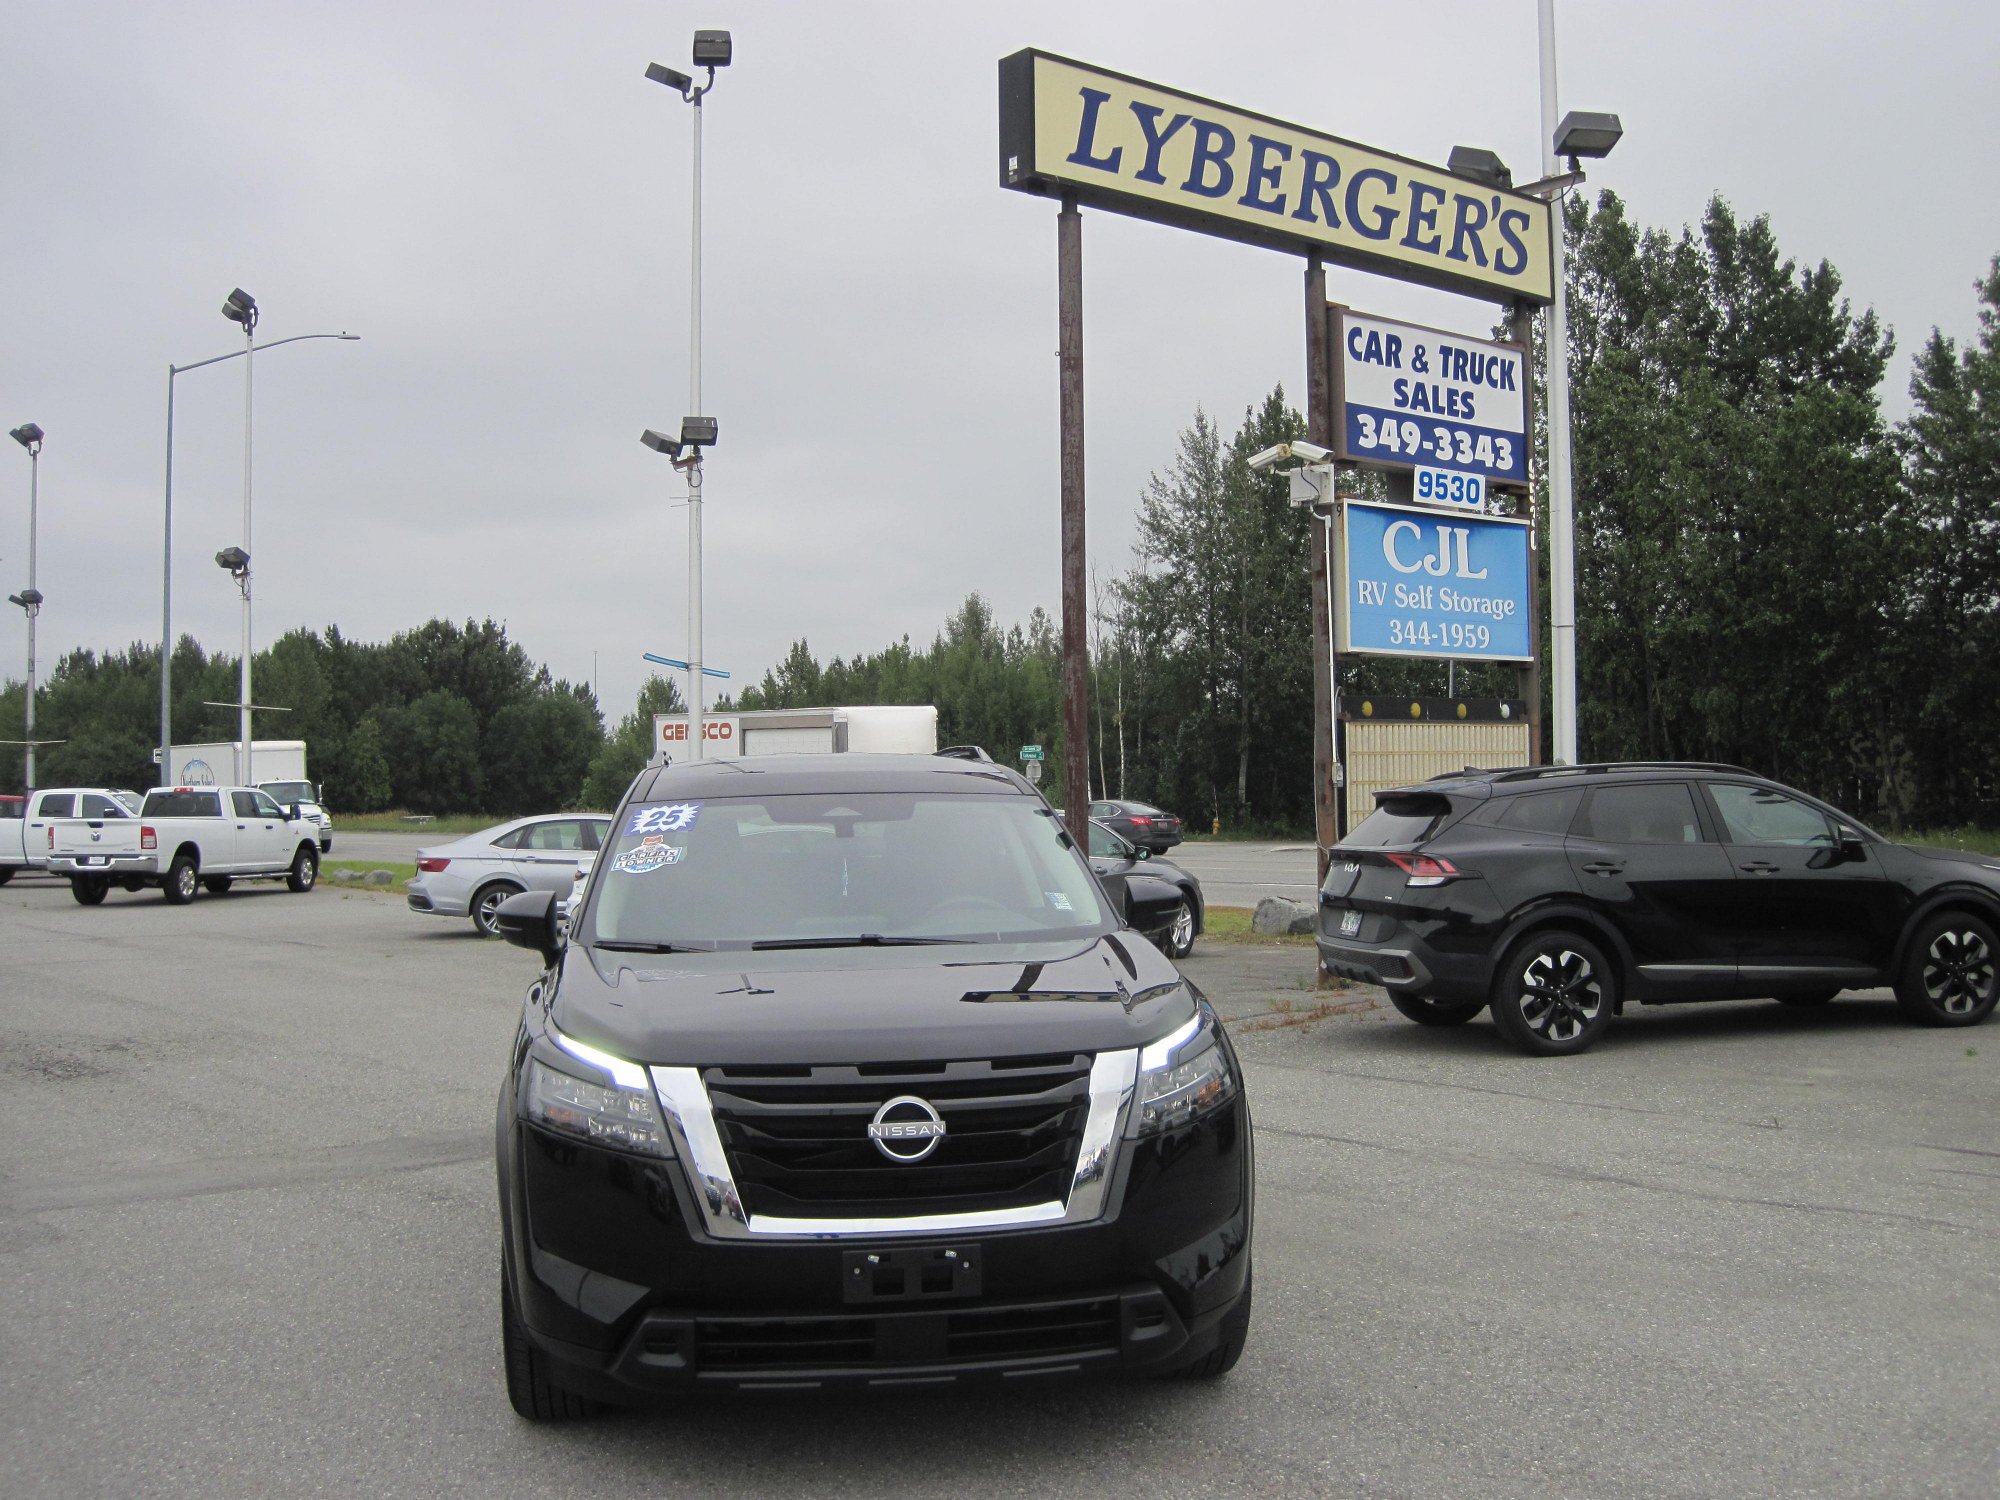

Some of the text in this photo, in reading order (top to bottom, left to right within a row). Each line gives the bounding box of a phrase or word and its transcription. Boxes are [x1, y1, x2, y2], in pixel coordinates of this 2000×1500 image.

[1066, 87, 1531, 276] LYBERGER'S
[1347, 326, 1516, 392] CAR & TRUCK
[1393, 378, 1476, 420] SALES
[1357, 413, 1514, 471] 349-3343
[1418, 471, 1480, 504] 9530
[1383, 520, 1488, 580] CJL
[1358, 580, 1515, 620] RV Self Storage
[1389, 619, 1490, 649] 344-1959
[662, 722, 732, 741] GECO
[643, 809, 684, 828] 25
[619, 850, 677, 862] CARFAX
[626, 856, 674, 867] OWNER
[870, 1124, 944, 1137] NISSAN
